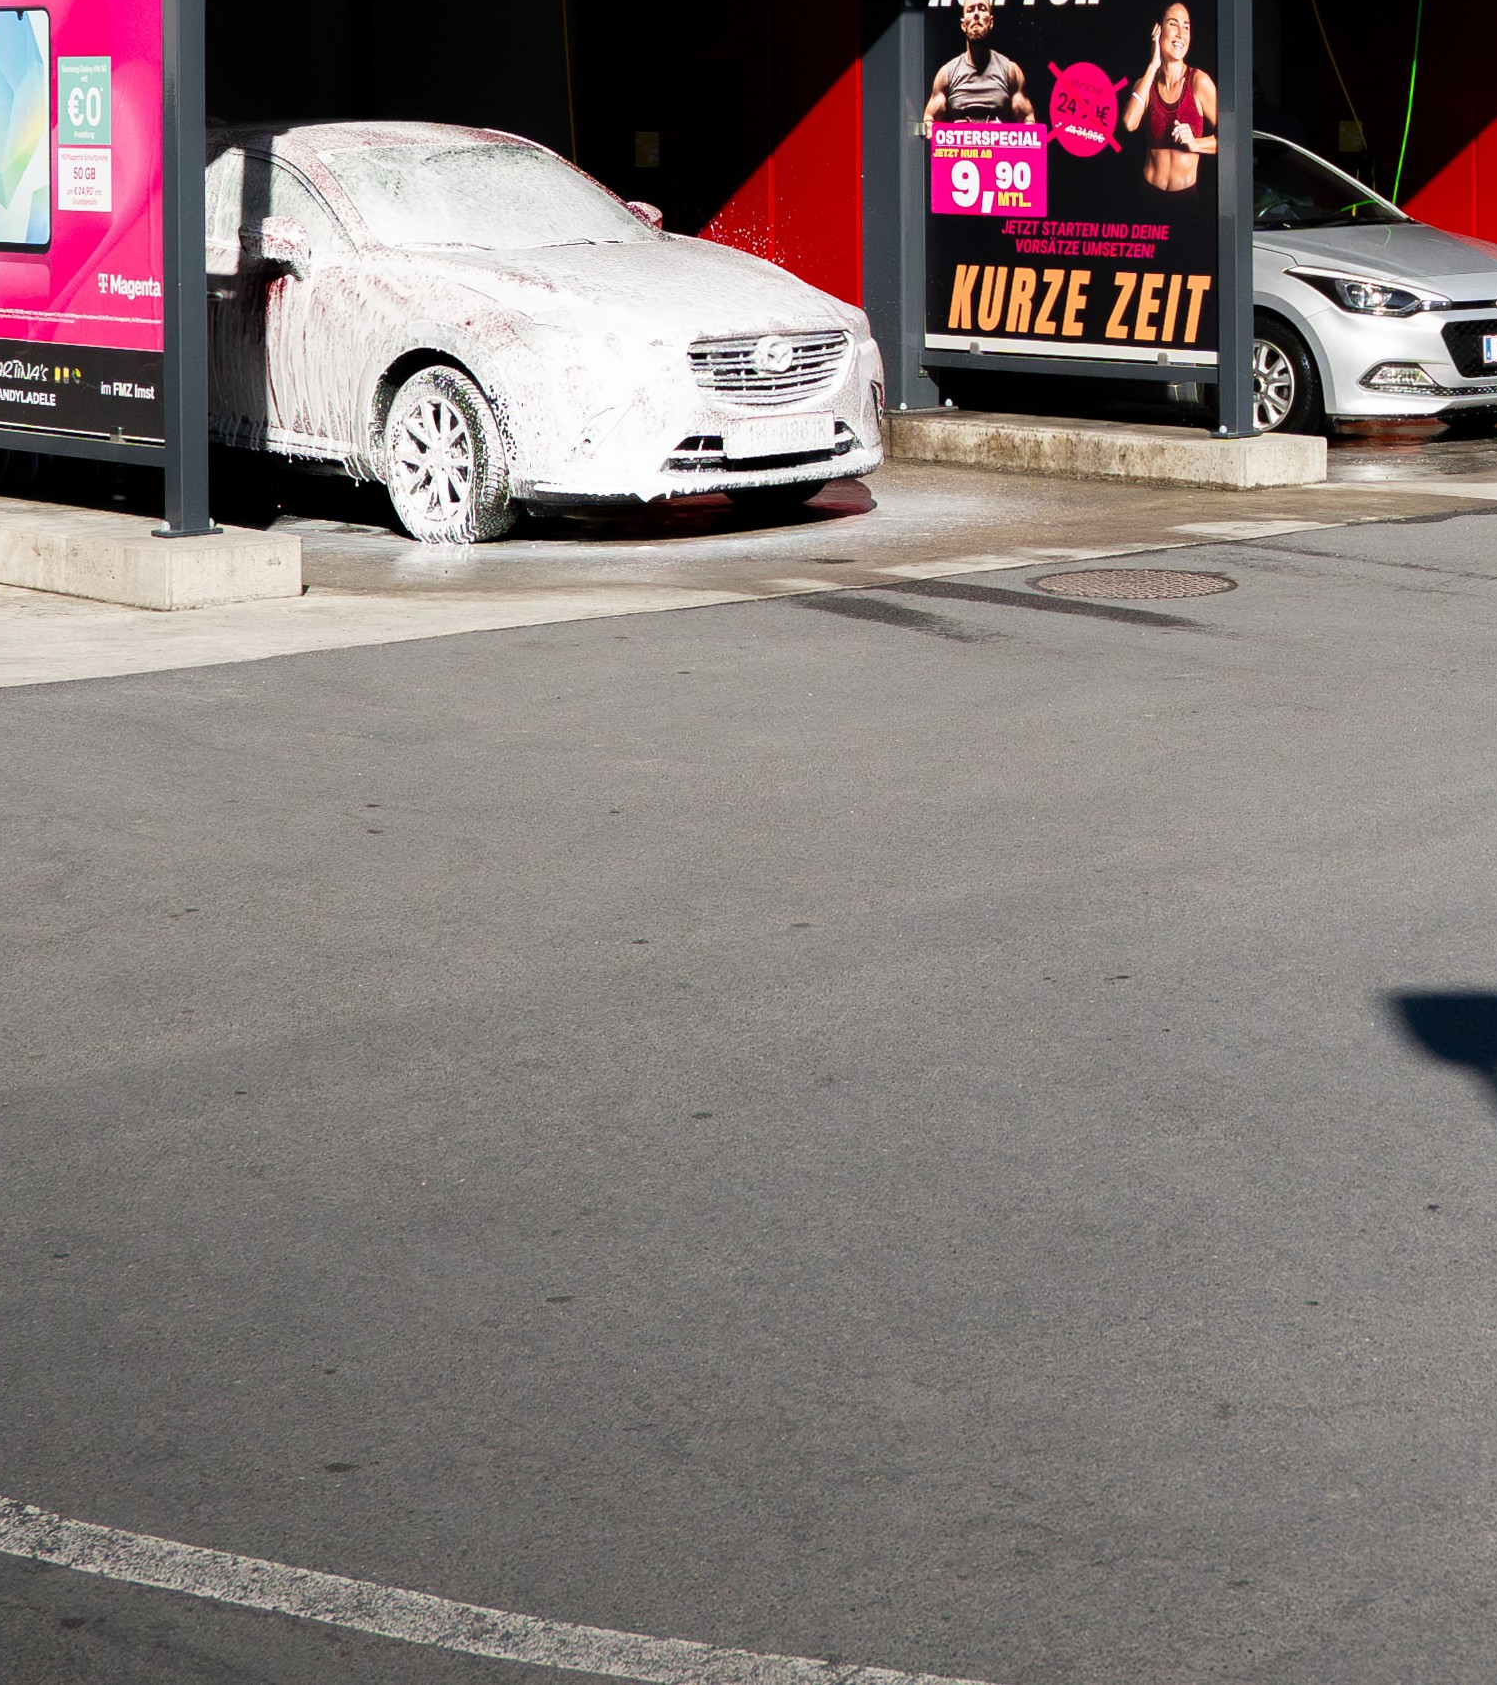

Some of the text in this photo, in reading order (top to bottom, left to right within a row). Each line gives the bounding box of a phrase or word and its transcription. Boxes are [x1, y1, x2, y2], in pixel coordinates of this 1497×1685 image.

[936, 130, 1042, 146] OSTERSPECIAL
[933, 148, 992, 159] JETZT NUR AB
[74, 167, 96, 180] 50 GB
[998, 191, 1032, 207] MTL.
[1001, 219, 1170, 240] JETZT STARTEN UND DEINE
[1015, 237, 1155, 259] VORSÄTZE UMSETZEN!
[110, 274, 162, 300] Magenta
[948, 264, 1211, 343] KURZE ZEIT
[101, 381, 155, 400] im FMZ Imst
